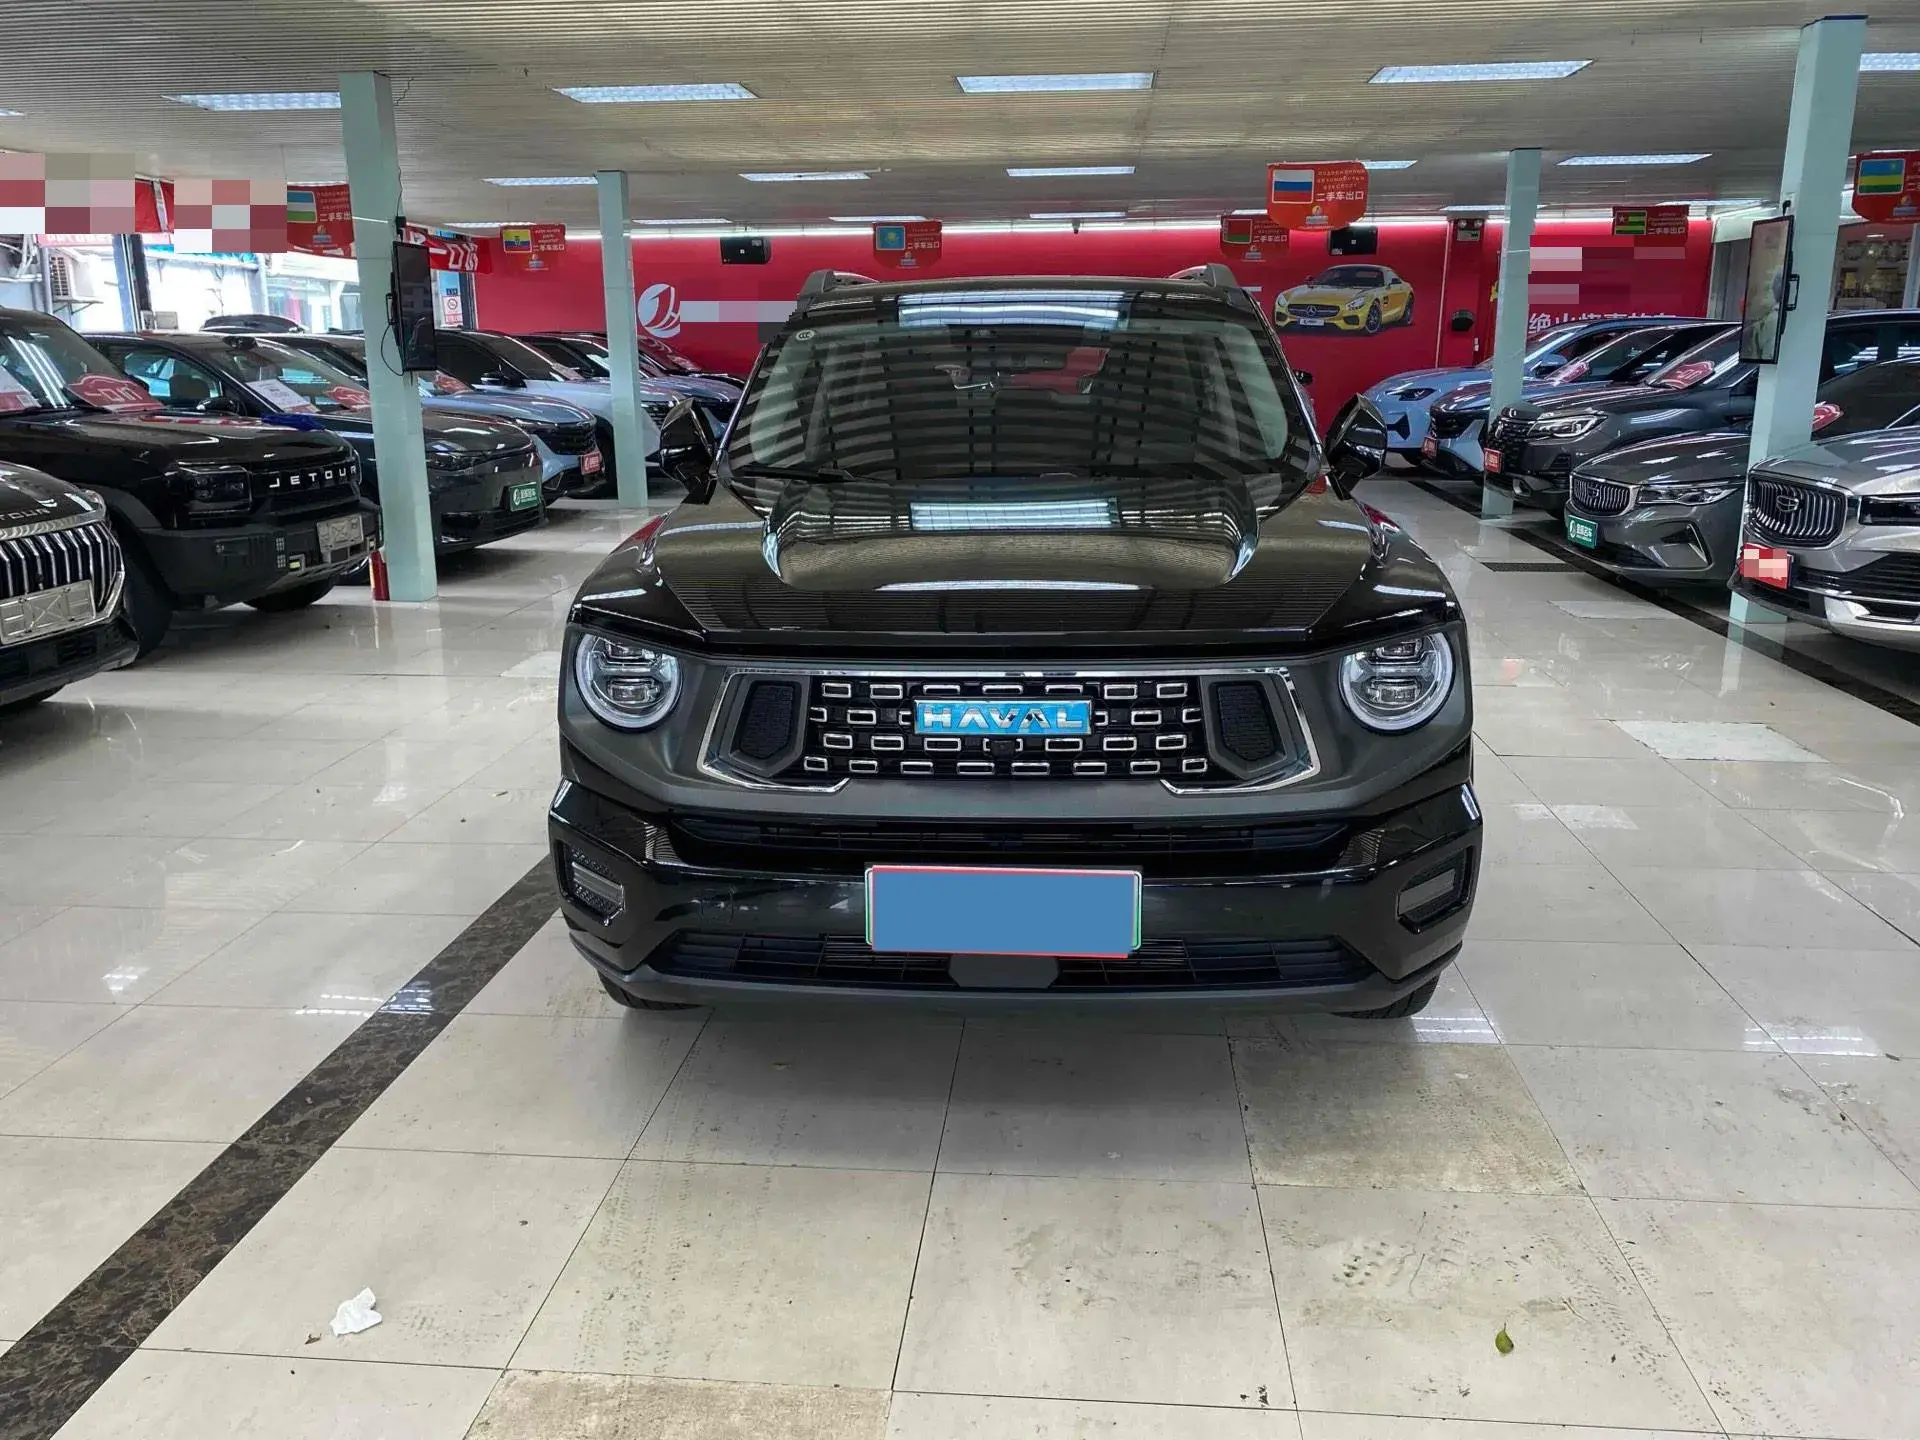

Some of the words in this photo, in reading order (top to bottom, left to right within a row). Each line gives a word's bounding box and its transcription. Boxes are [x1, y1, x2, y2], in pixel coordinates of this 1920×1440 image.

[1316, 190, 1364, 202] 二手车出口
[319, 212, 352, 222] 二手车出
[269, 465, 357, 488] JETOUR
[923, 707, 1084, 729] HAVAL
